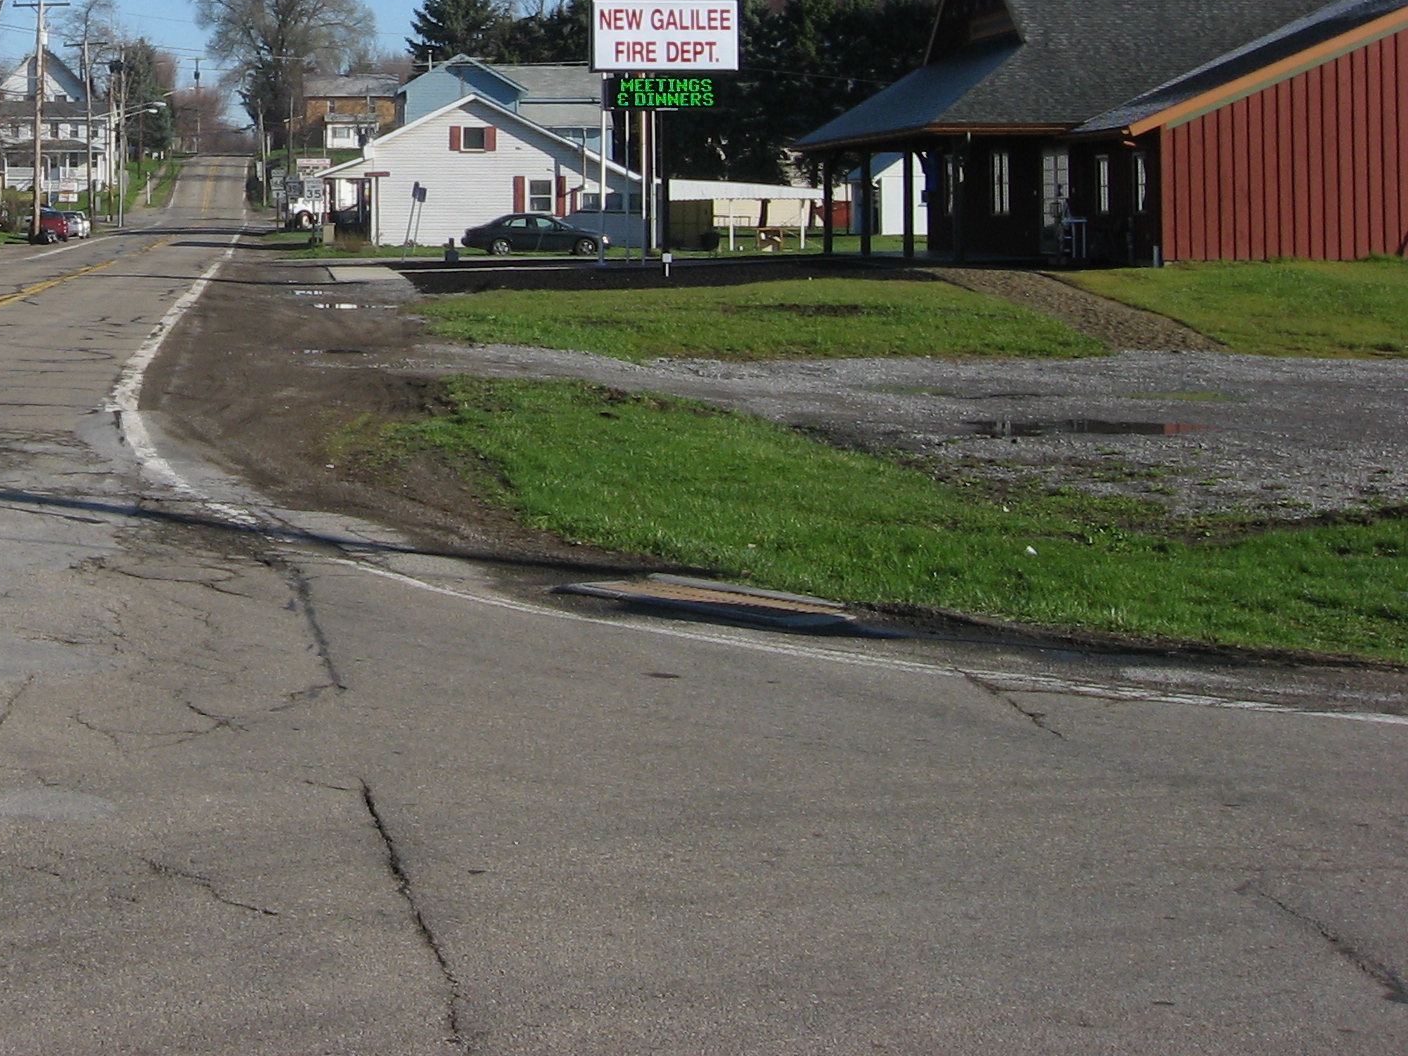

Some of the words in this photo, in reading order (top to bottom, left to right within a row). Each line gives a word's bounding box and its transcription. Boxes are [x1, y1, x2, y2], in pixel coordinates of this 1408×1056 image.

[599, 9, 643, 30] NEW
[650, 9, 731, 30] GALILEE
[614, 41, 657, 62] FIRE
[666, 41, 719, 62] DEPT.
[620, 78, 712, 92] MEETINGS
[617, 93, 628, 106] &
[635, 93, 714, 106] DINNERS
[306, 189, 321, 199] 35
